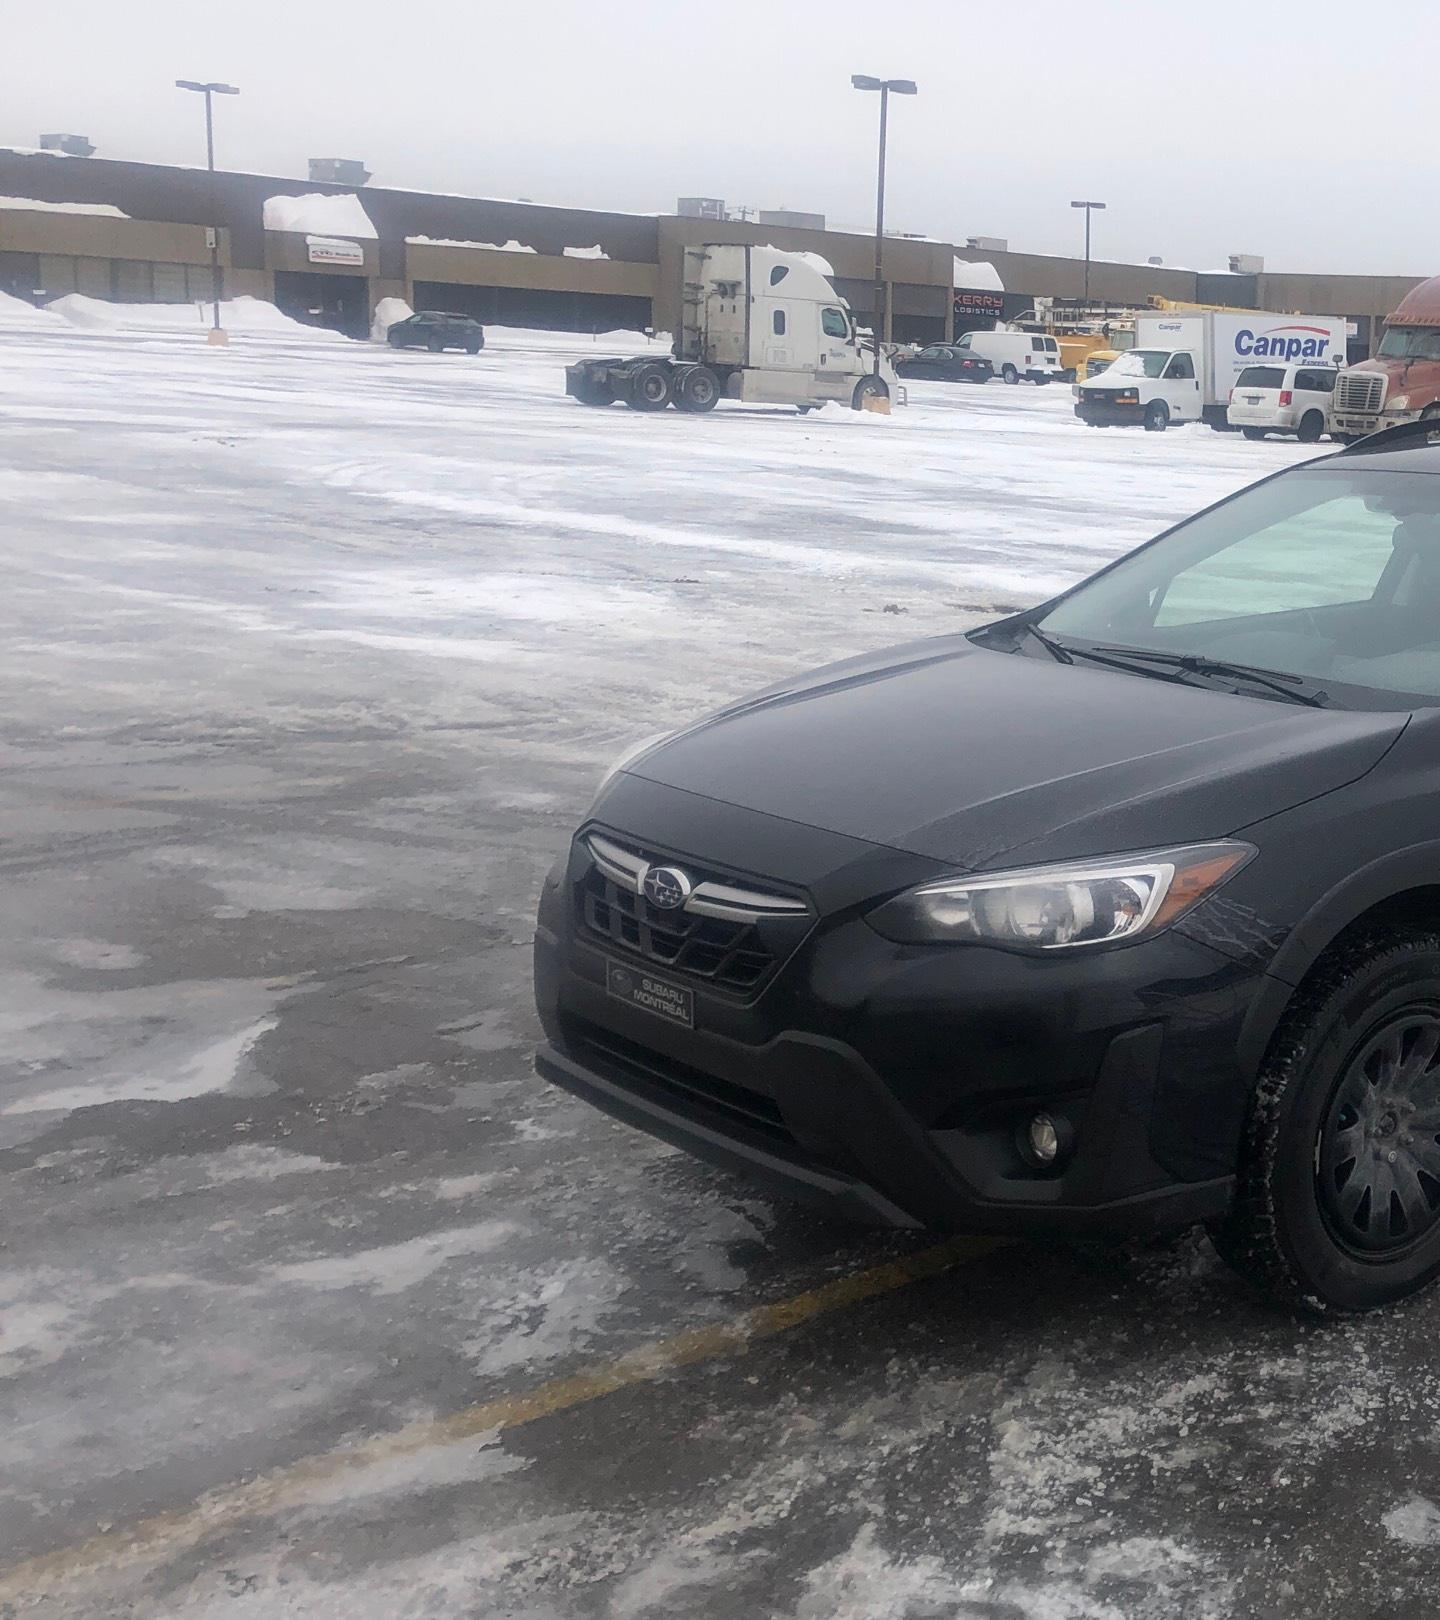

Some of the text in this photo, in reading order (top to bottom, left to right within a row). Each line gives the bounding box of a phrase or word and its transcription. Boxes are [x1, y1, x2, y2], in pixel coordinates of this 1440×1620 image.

[953, 295, 1003, 307] KERRY
[954, 307, 1000, 316] LOGISTICS
[1234, 329, 1330, 361] Canpar
[642, 979, 683, 1005] SUBARU
